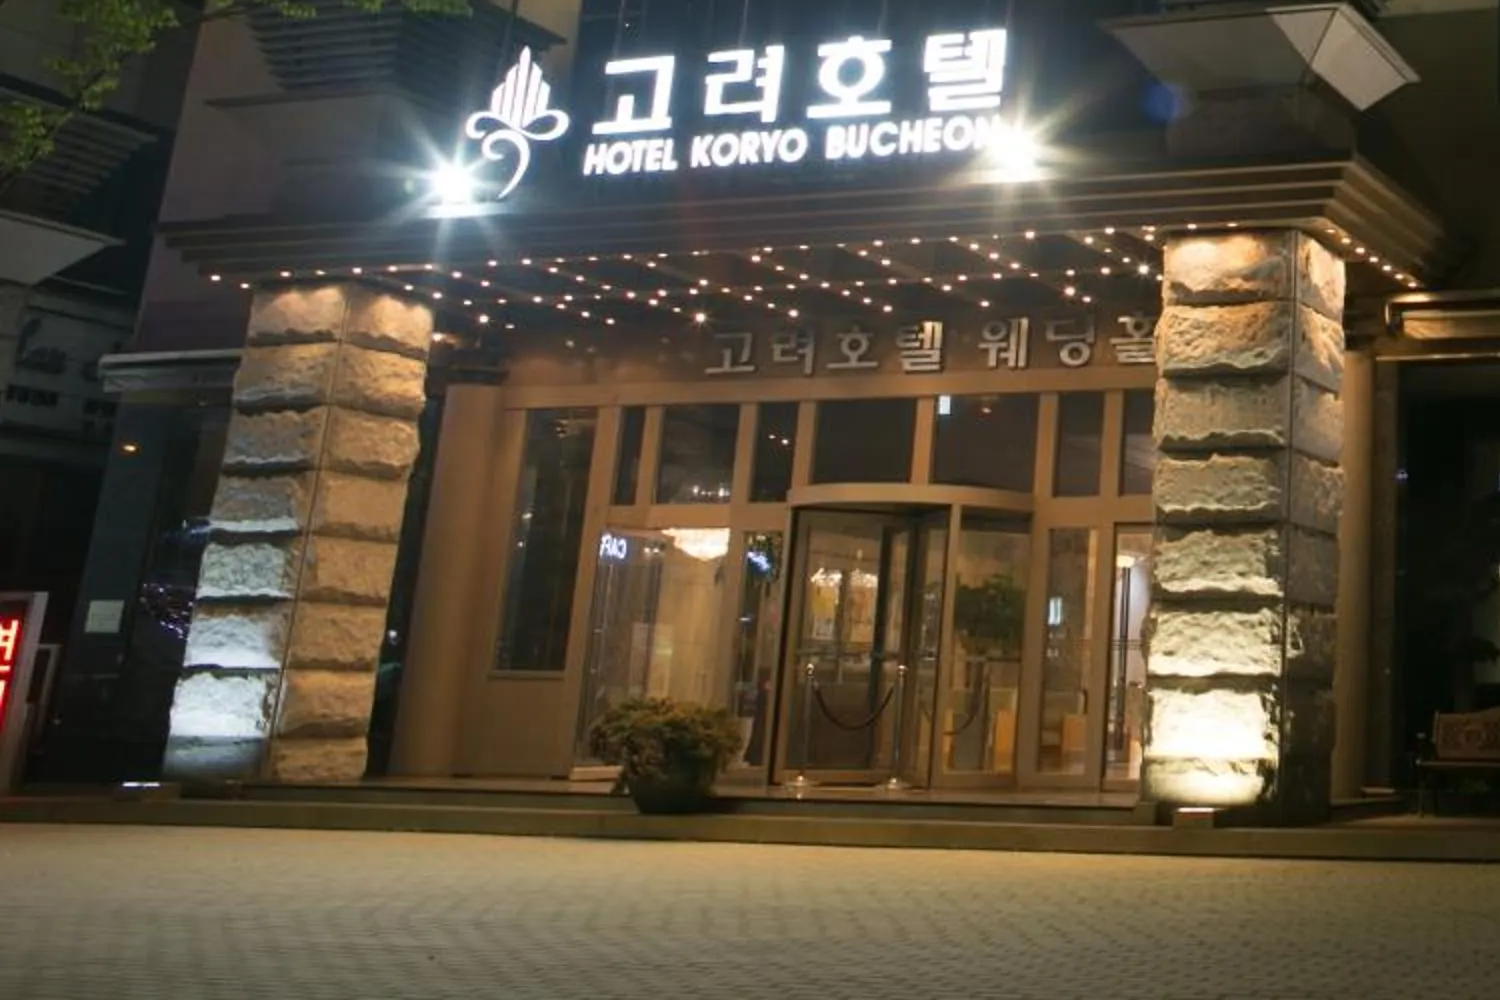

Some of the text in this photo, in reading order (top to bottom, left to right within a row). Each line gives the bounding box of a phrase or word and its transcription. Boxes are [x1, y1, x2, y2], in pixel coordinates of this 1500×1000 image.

[592, 28, 1007, 135] 고려호텔
[583, 114, 1008, 176] HOTEL KORYO BUCHEON
[704, 313, 1155, 376] 고려호텔 웨딩홀
